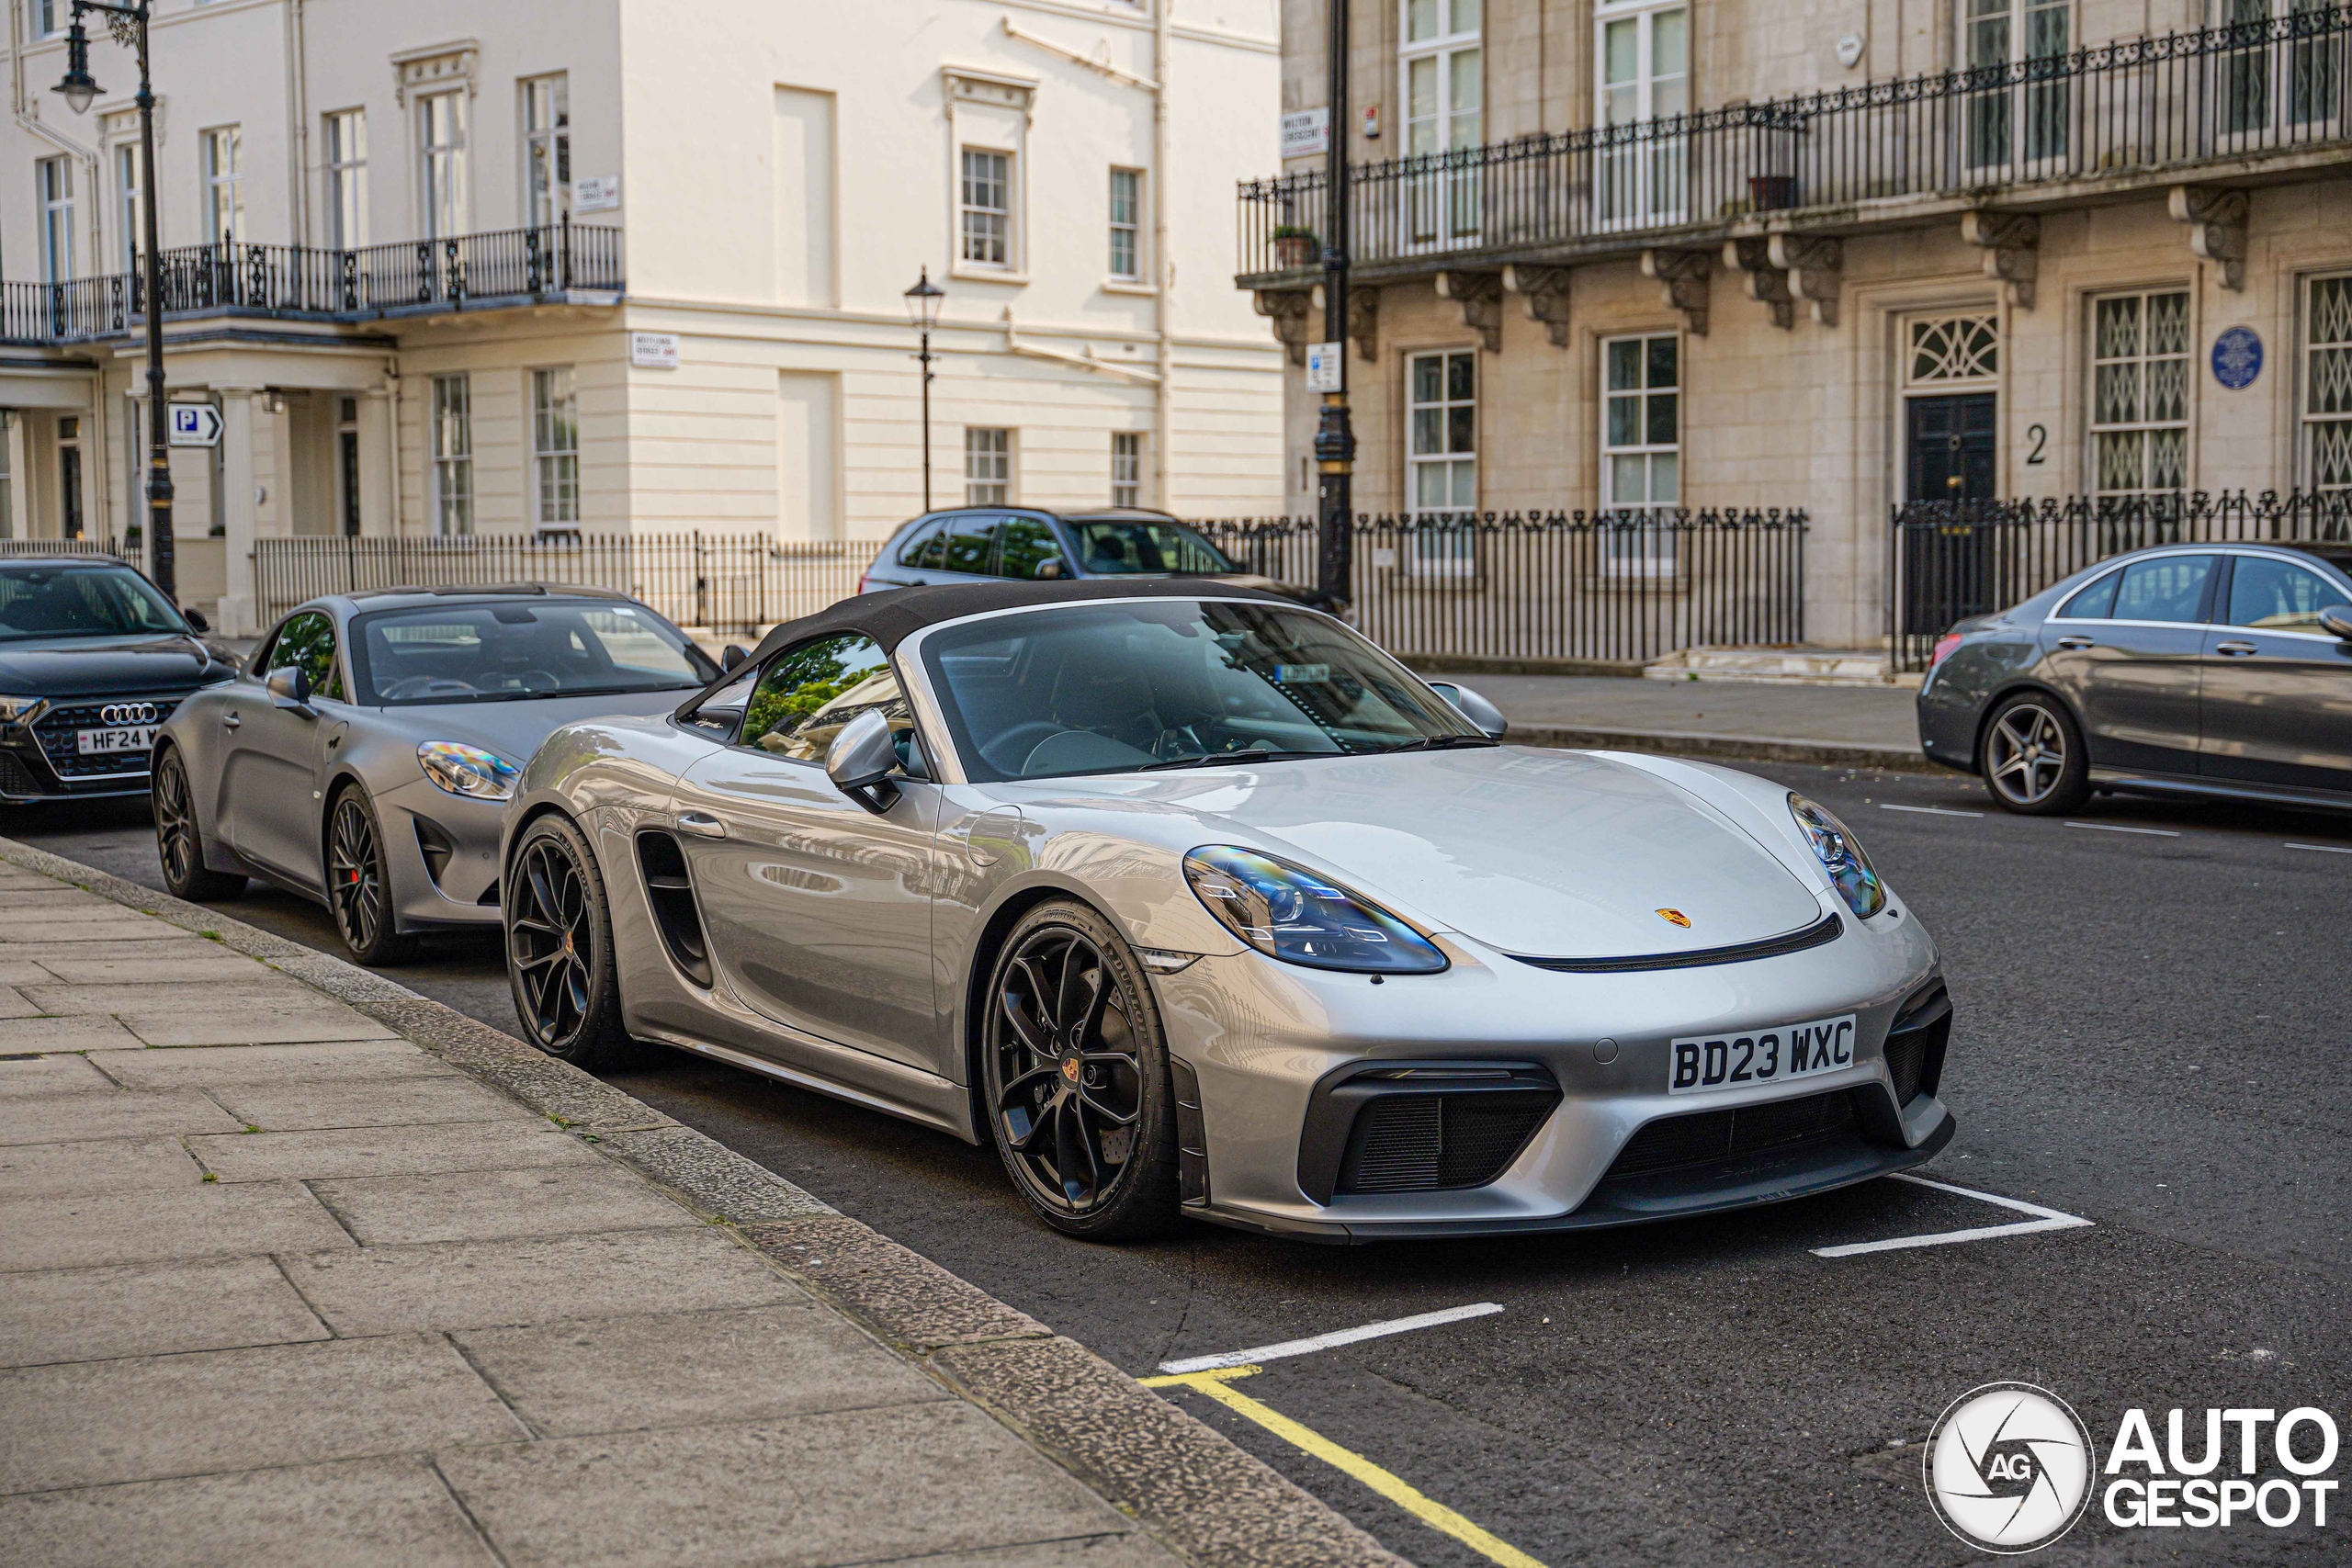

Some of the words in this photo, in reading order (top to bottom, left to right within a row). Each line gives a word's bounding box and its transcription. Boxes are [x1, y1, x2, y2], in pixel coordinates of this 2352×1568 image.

[179, 410, 196, 431] P
[2027, 423, 2047, 465] 2
[93, 729, 141, 750] HF24
[1114, 958, 1148, 1040] DUNLOP
[1673, 1034, 1780, 1089] BD23
[1791, 1021, 1852, 1074] WXC
